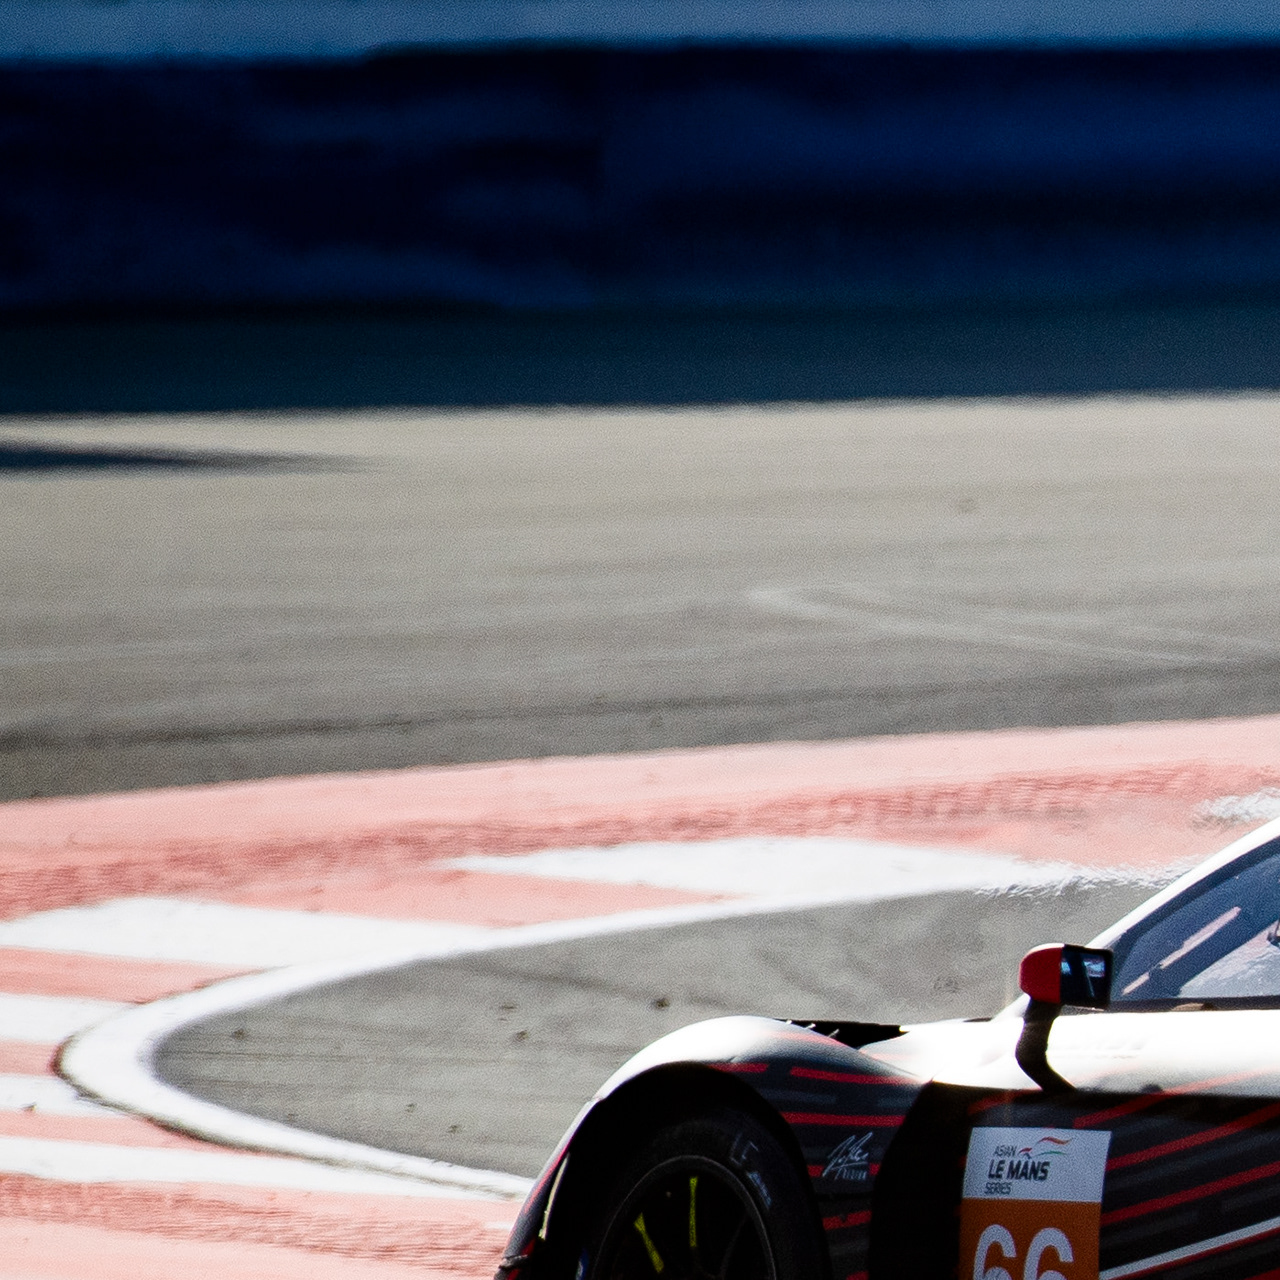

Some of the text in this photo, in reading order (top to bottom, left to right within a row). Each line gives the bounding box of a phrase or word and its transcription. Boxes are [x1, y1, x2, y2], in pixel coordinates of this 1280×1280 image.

[993, 1145, 1017, 1157] ASIAN
[988, 1159, 1050, 1181] LE MANS
[984, 1182, 1012, 1195] SERIES
